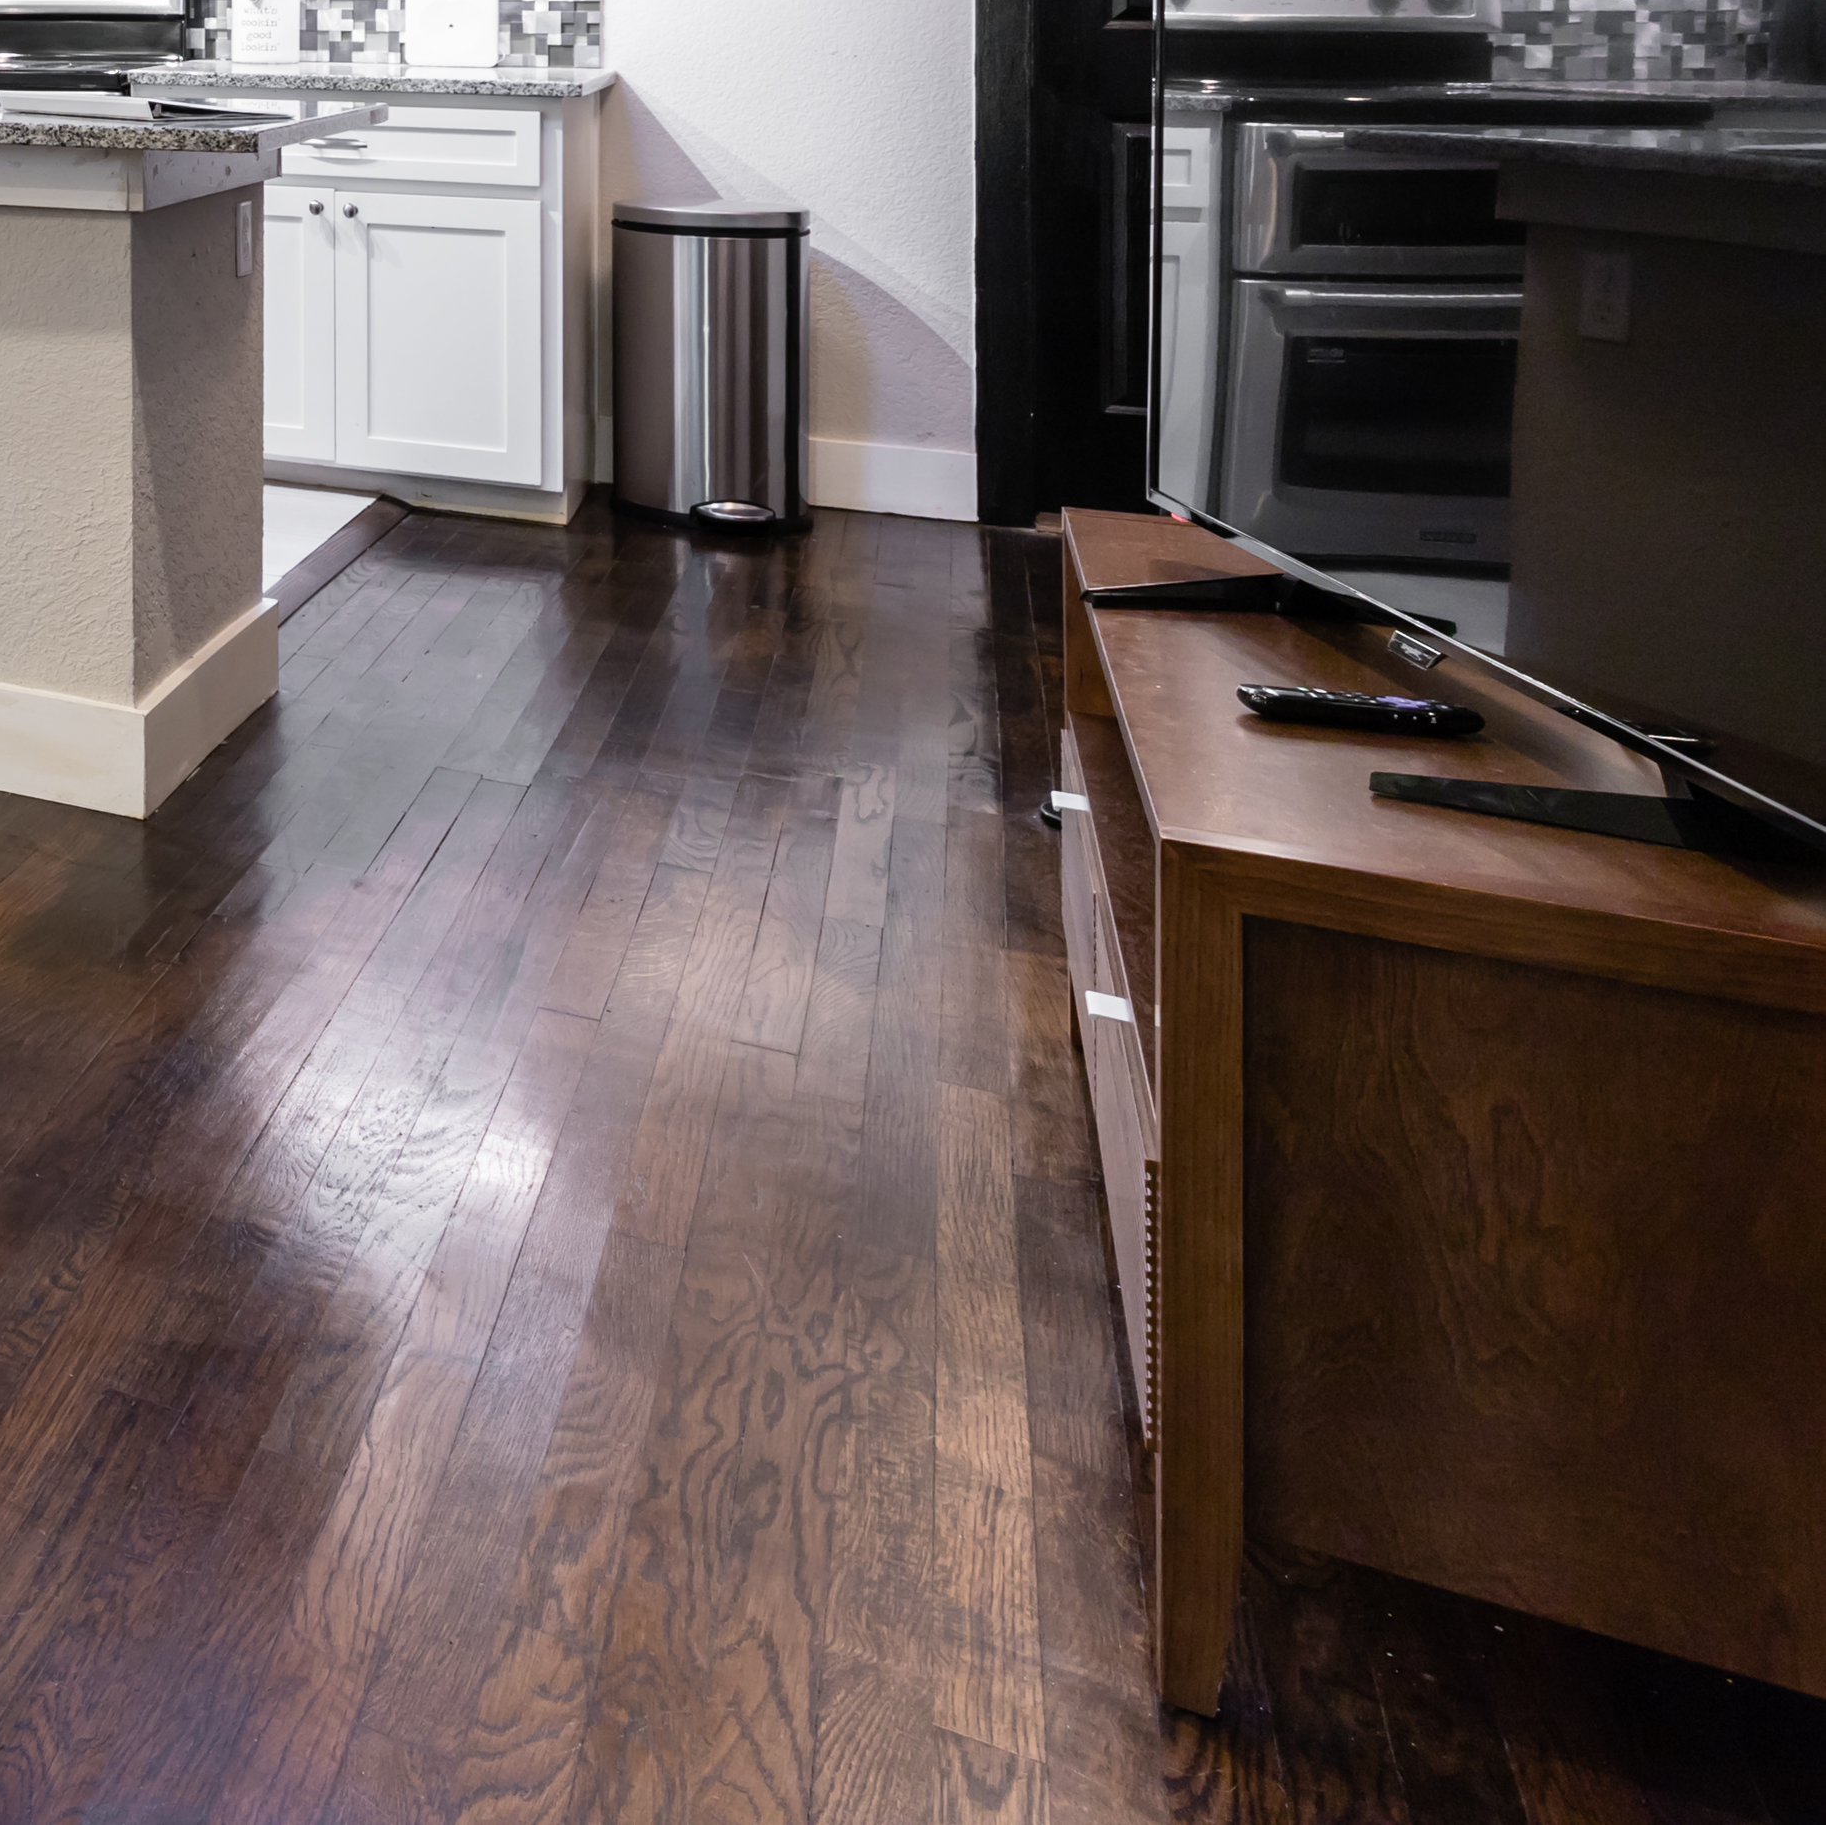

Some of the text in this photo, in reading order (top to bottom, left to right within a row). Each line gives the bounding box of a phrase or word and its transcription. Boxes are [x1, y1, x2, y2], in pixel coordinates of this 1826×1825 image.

[241, 18, 280, 27] cookin'
[246, 30, 272, 42] good
[241, 42, 280, 52] lookin'
